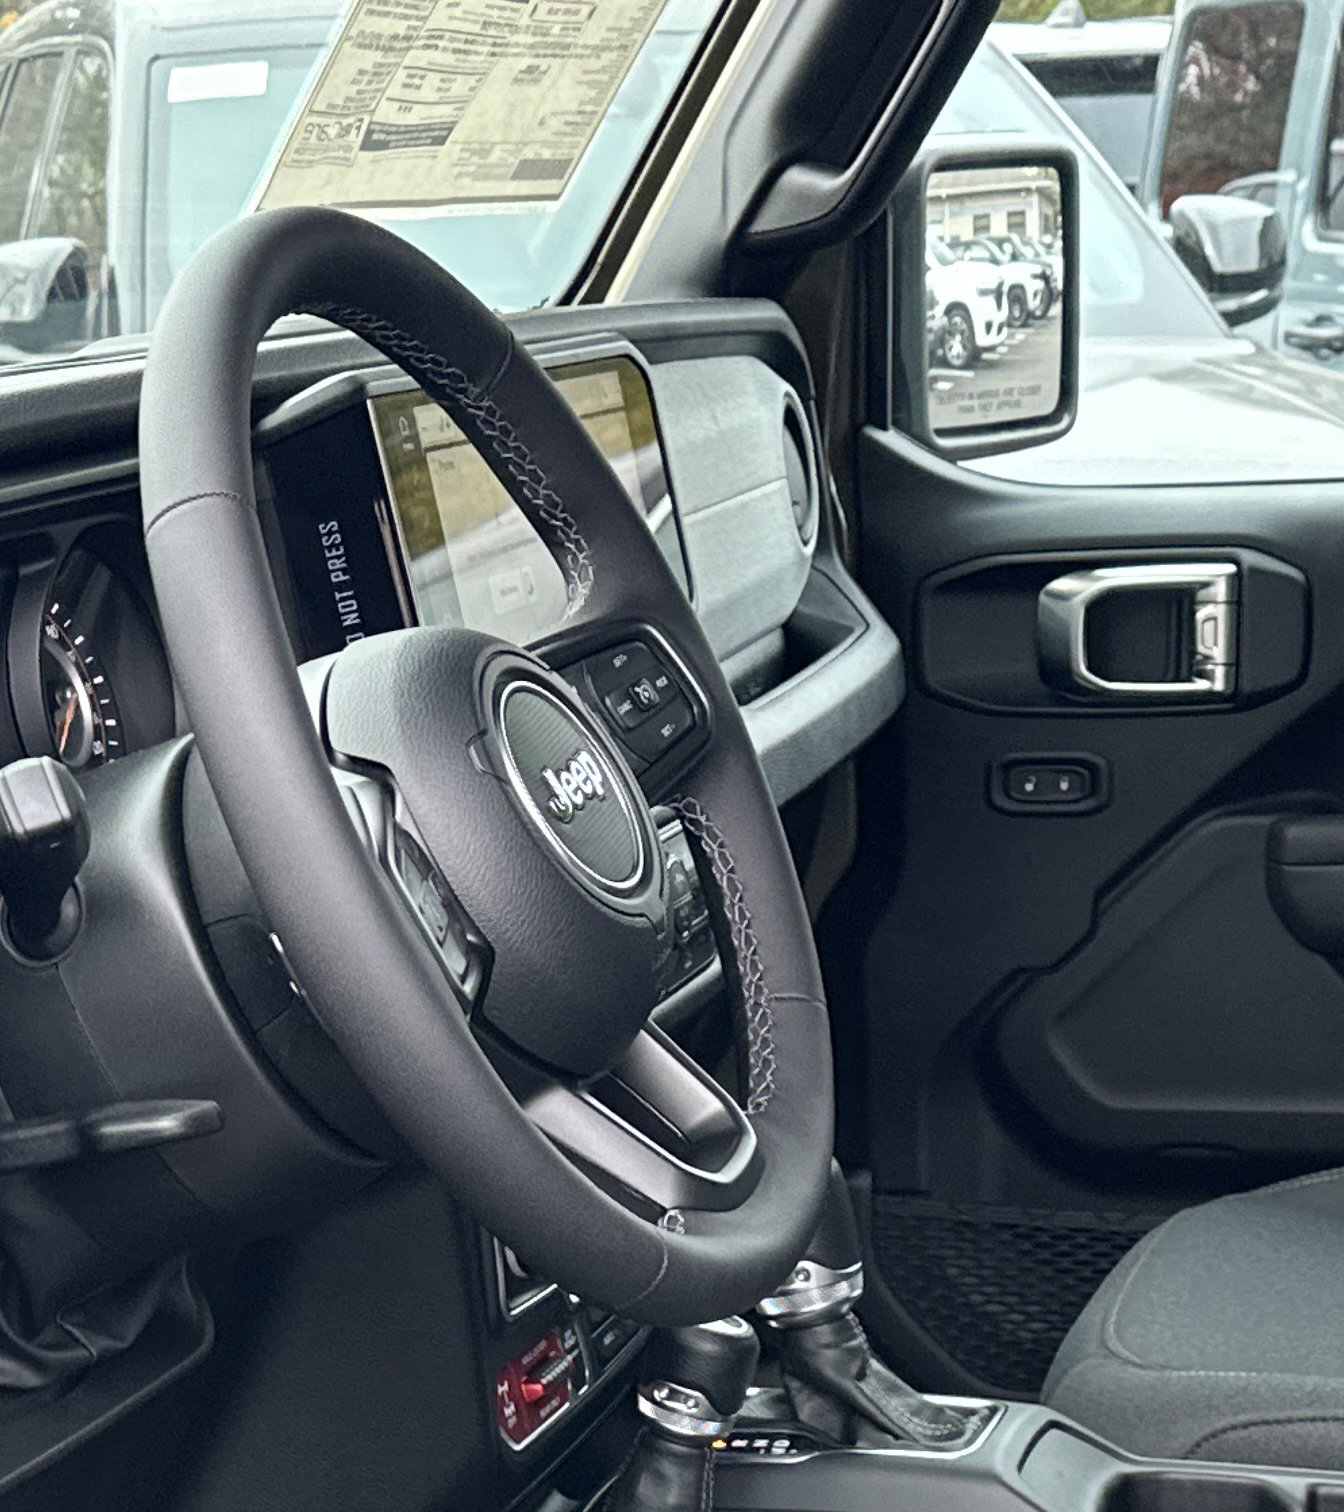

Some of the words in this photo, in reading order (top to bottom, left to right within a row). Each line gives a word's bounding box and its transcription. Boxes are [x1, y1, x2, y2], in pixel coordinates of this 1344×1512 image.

[317, 520, 352, 584] PRESS
[333, 589, 363, 628] NOT
[541, 750, 606, 821] Jeep
